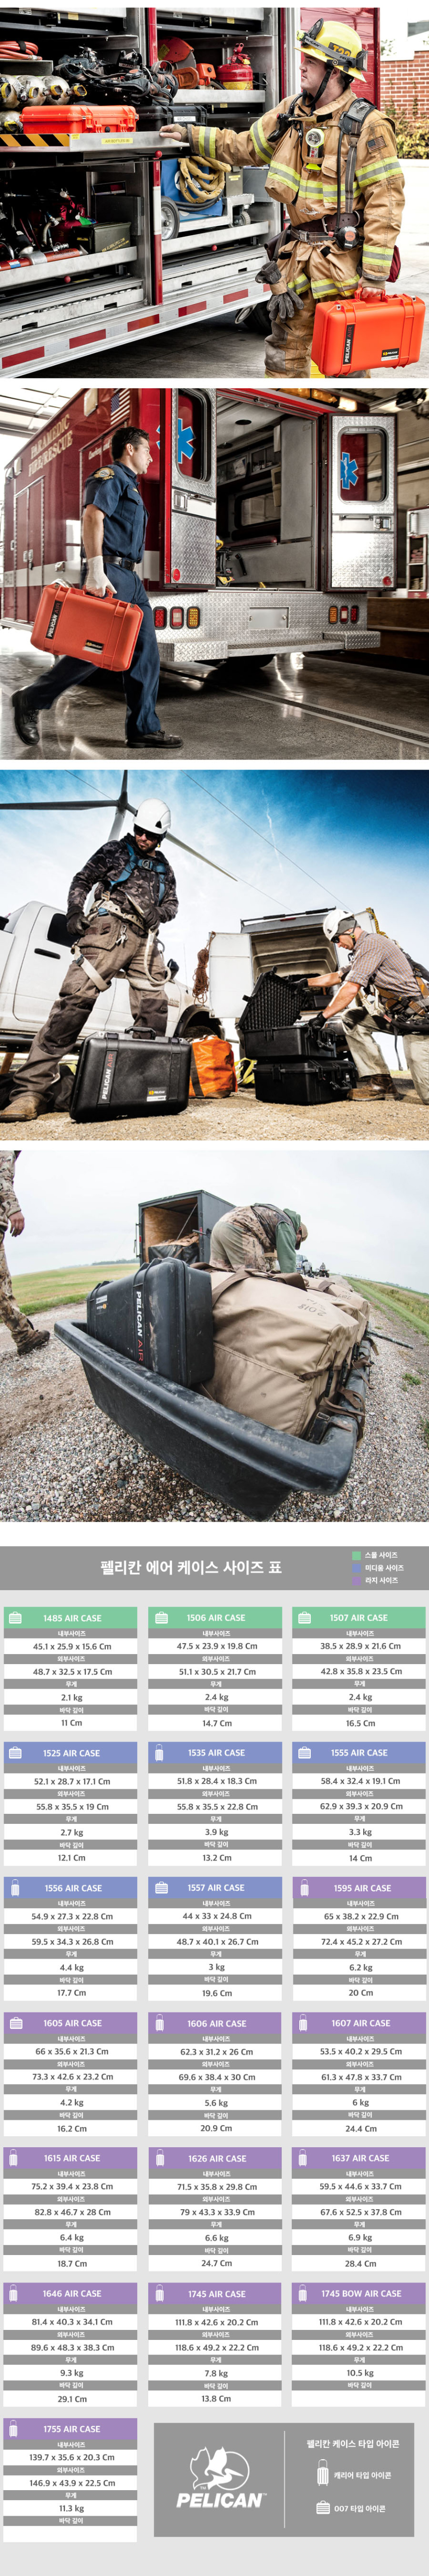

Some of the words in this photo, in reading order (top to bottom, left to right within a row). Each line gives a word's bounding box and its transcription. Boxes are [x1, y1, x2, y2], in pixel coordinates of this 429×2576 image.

[30, 413, 70, 460] PARAMEDIC
[28, 430, 73, 477] FIRE/RESCUE
[48, 614, 58, 637] PELICAN
[102, 1069, 112, 1100] PELICAN
[297, 1303, 327, 1316] 2018
